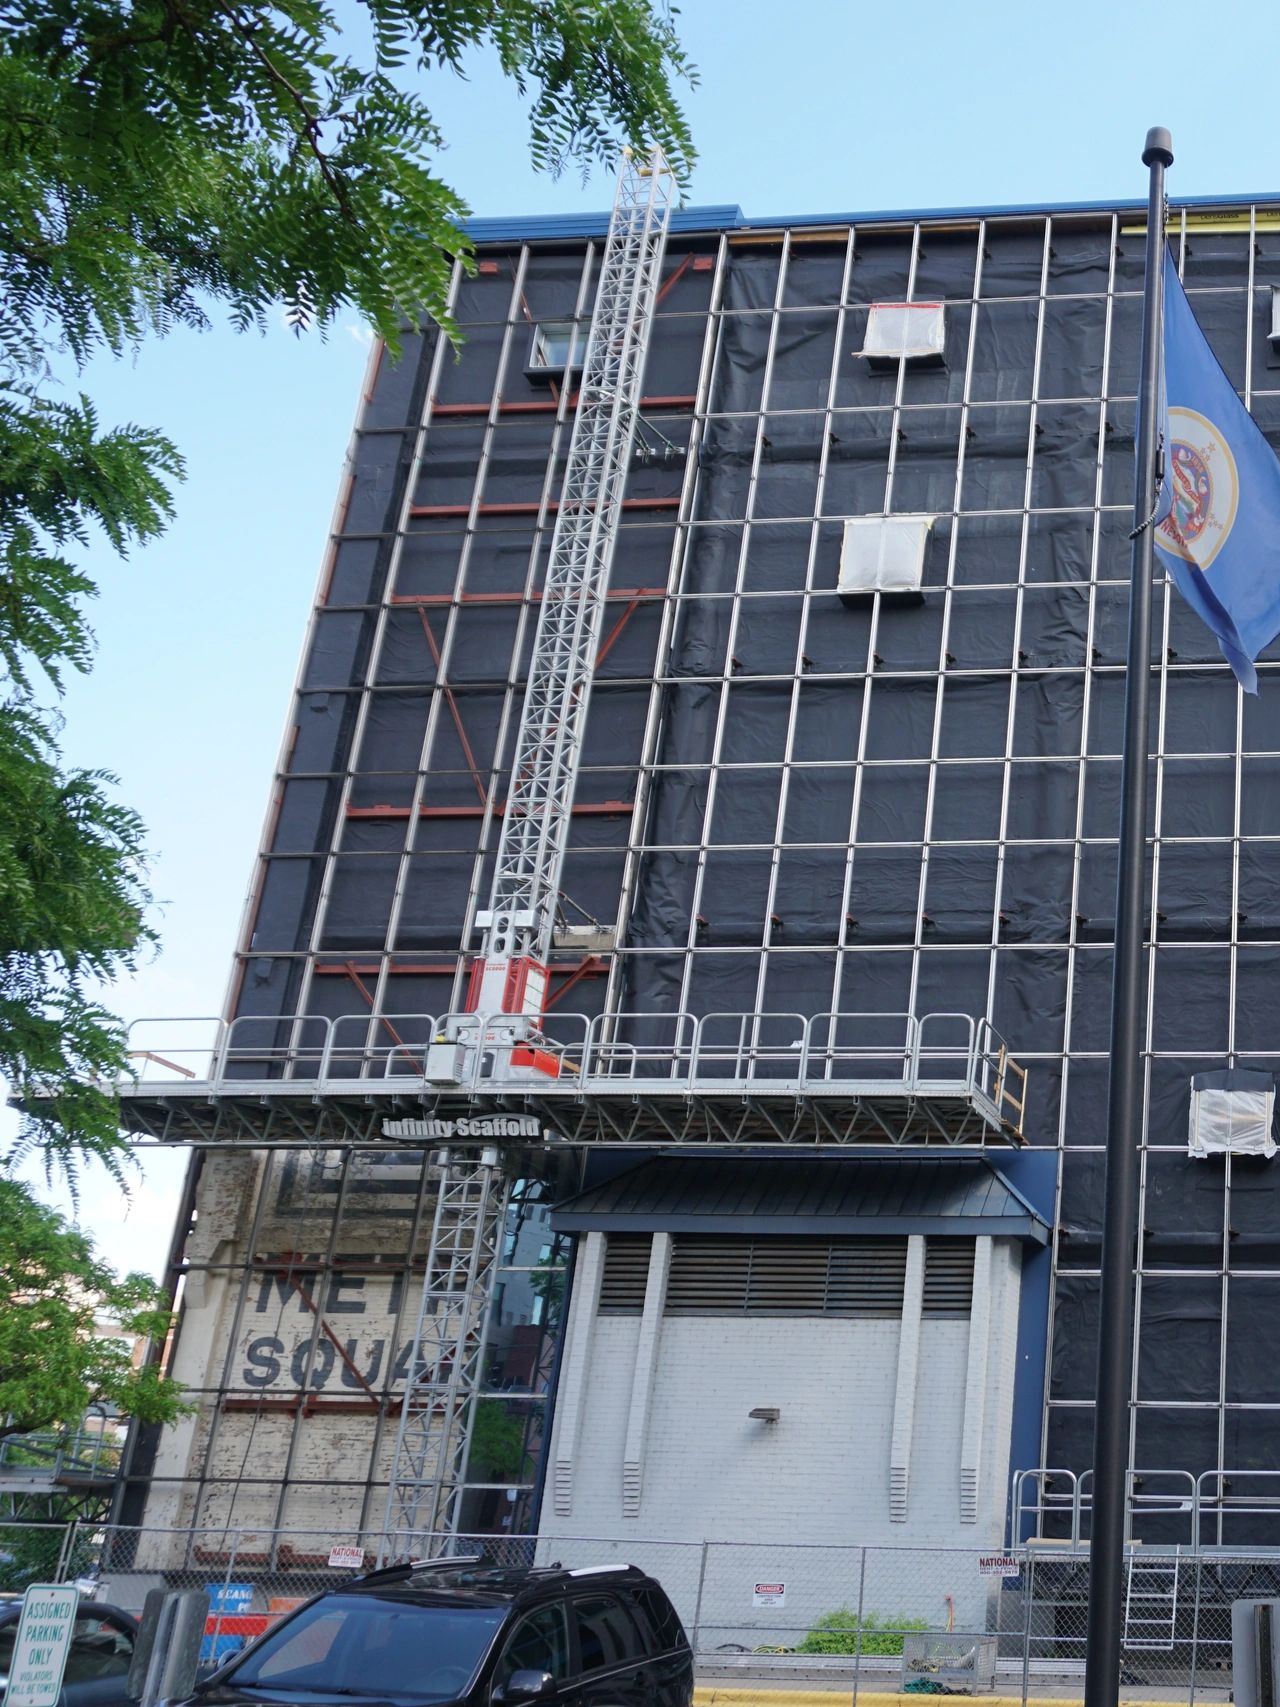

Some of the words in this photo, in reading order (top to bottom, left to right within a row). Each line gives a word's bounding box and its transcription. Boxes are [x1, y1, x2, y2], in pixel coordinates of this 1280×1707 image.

[456, 1117, 539, 1137] Scaffold
[980, 1557, 1018, 1567] NATIONAL
[27, 1602, 71, 1619] ASSIGNED
[26, 1625, 63, 1641] PARKING
[29, 1647, 53, 1665] ONLY
